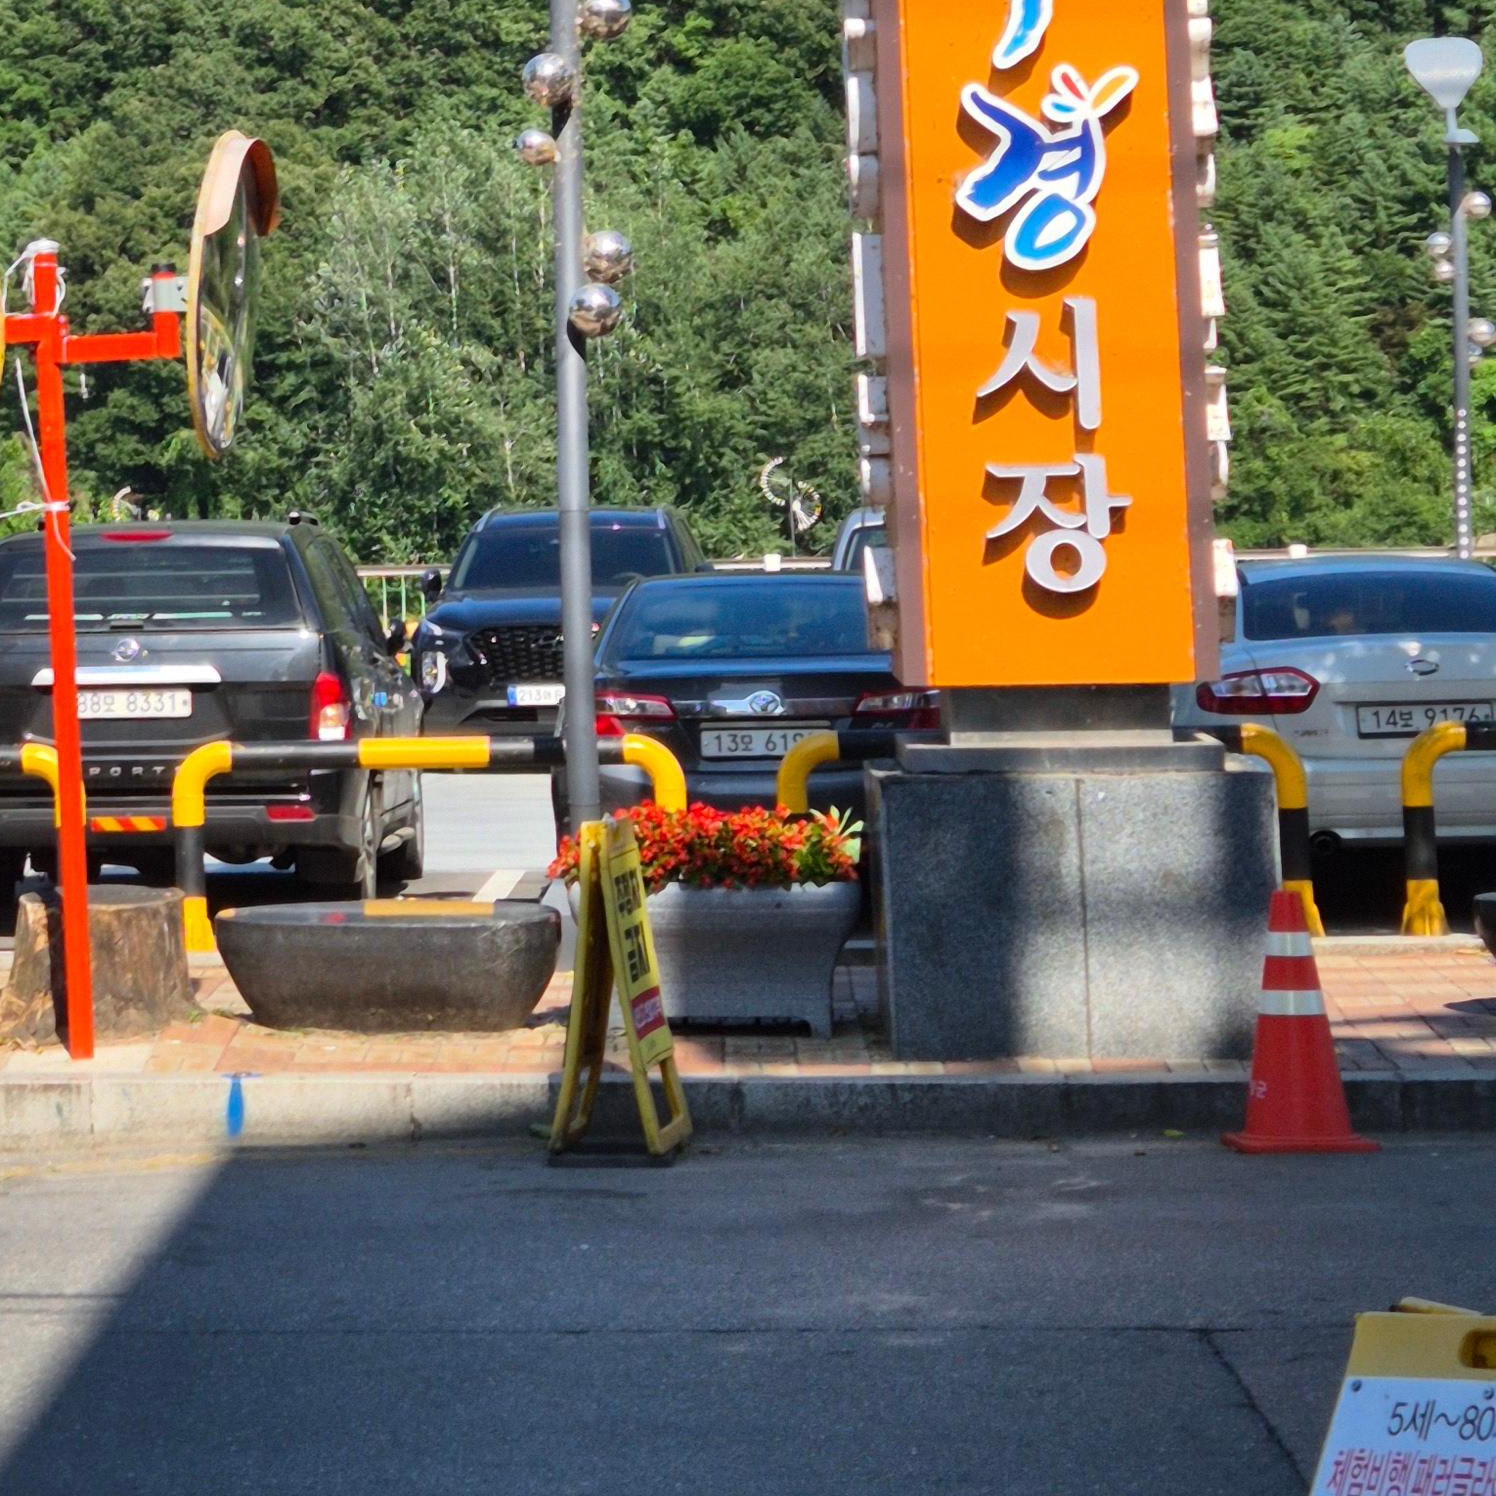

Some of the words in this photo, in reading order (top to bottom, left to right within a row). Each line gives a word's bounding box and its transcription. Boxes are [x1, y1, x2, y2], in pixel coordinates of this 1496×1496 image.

[126, 691, 176, 712] 8331
[1372, 708, 1413, 729] 14보
[1387, 1399, 1496, 1441] 5세~80
